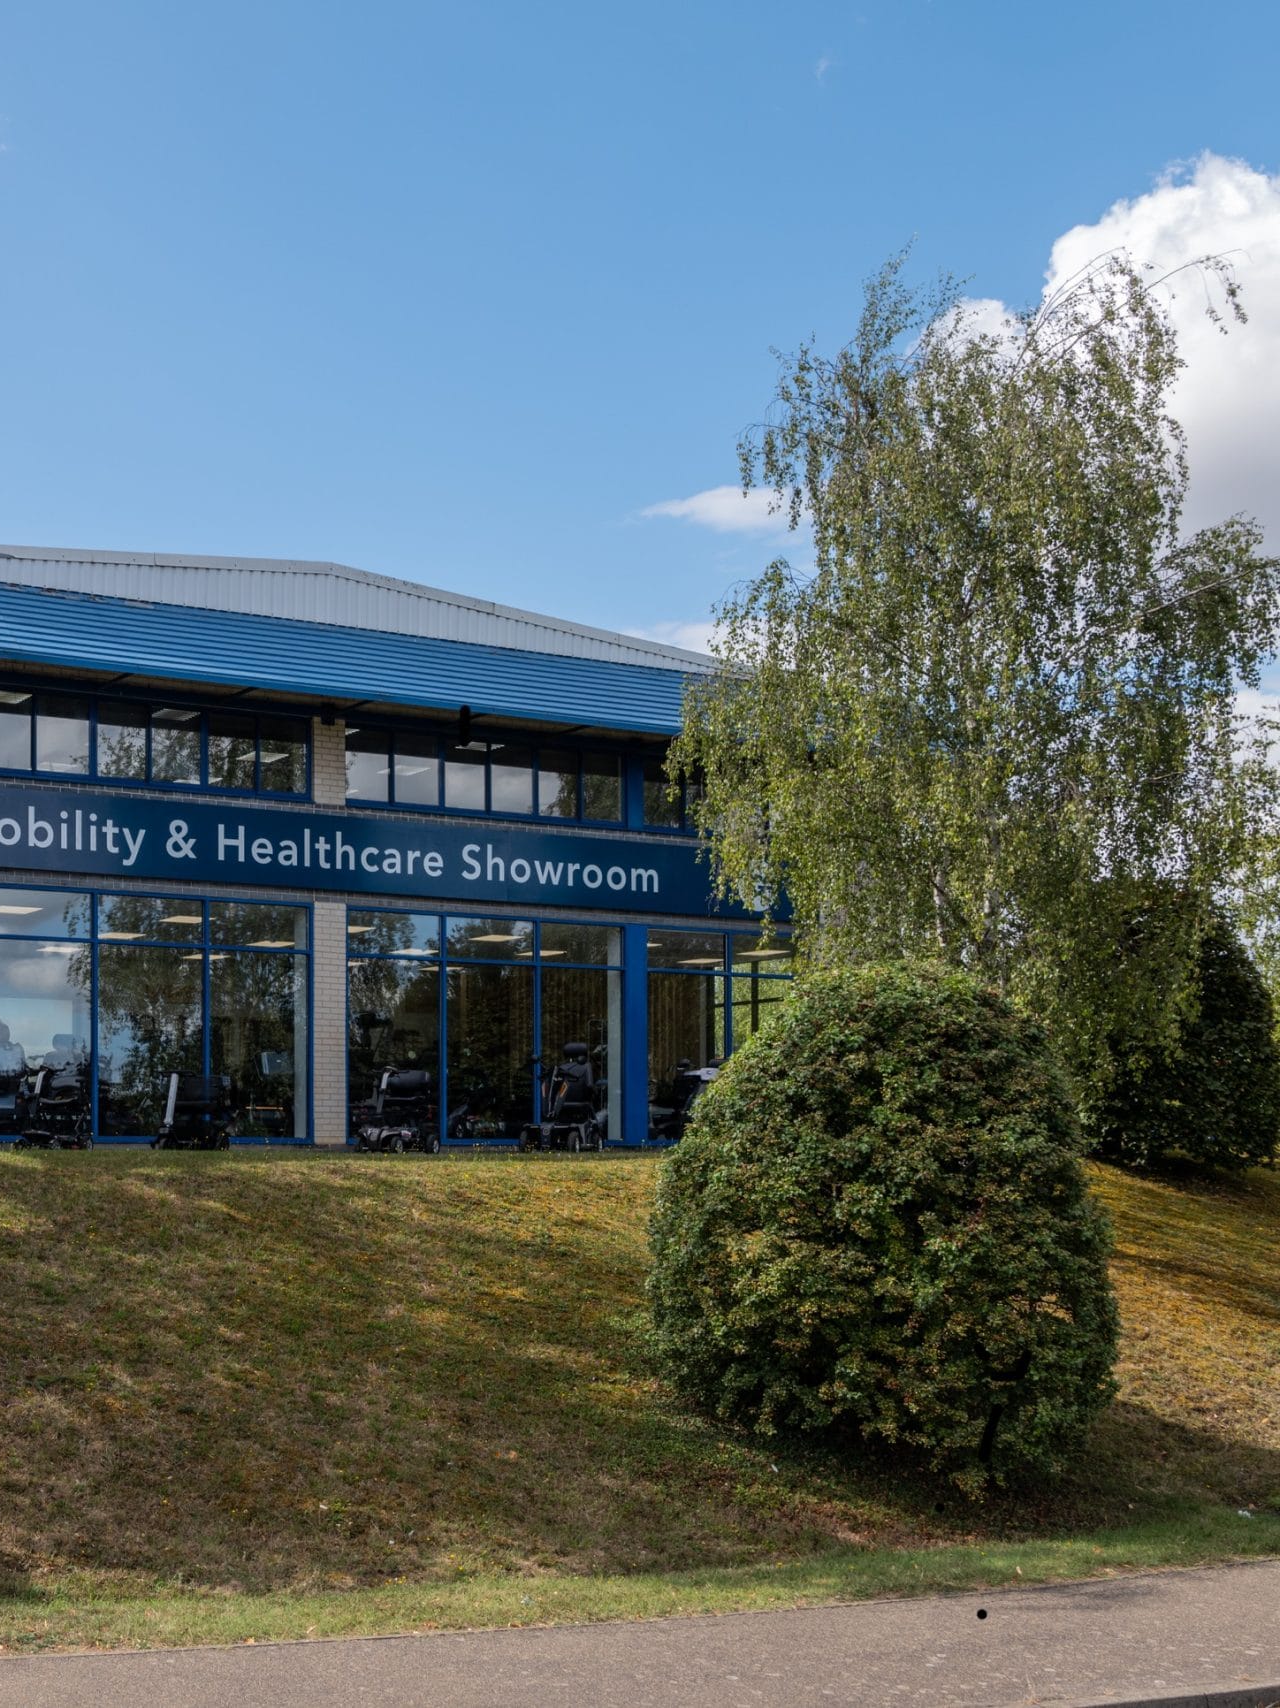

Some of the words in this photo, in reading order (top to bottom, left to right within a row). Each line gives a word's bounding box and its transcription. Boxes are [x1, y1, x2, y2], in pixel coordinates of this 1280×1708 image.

[166, 819, 197, 859] &
[217, 822, 445, 878] Healthcare
[460, 842, 660, 894] Showroom
